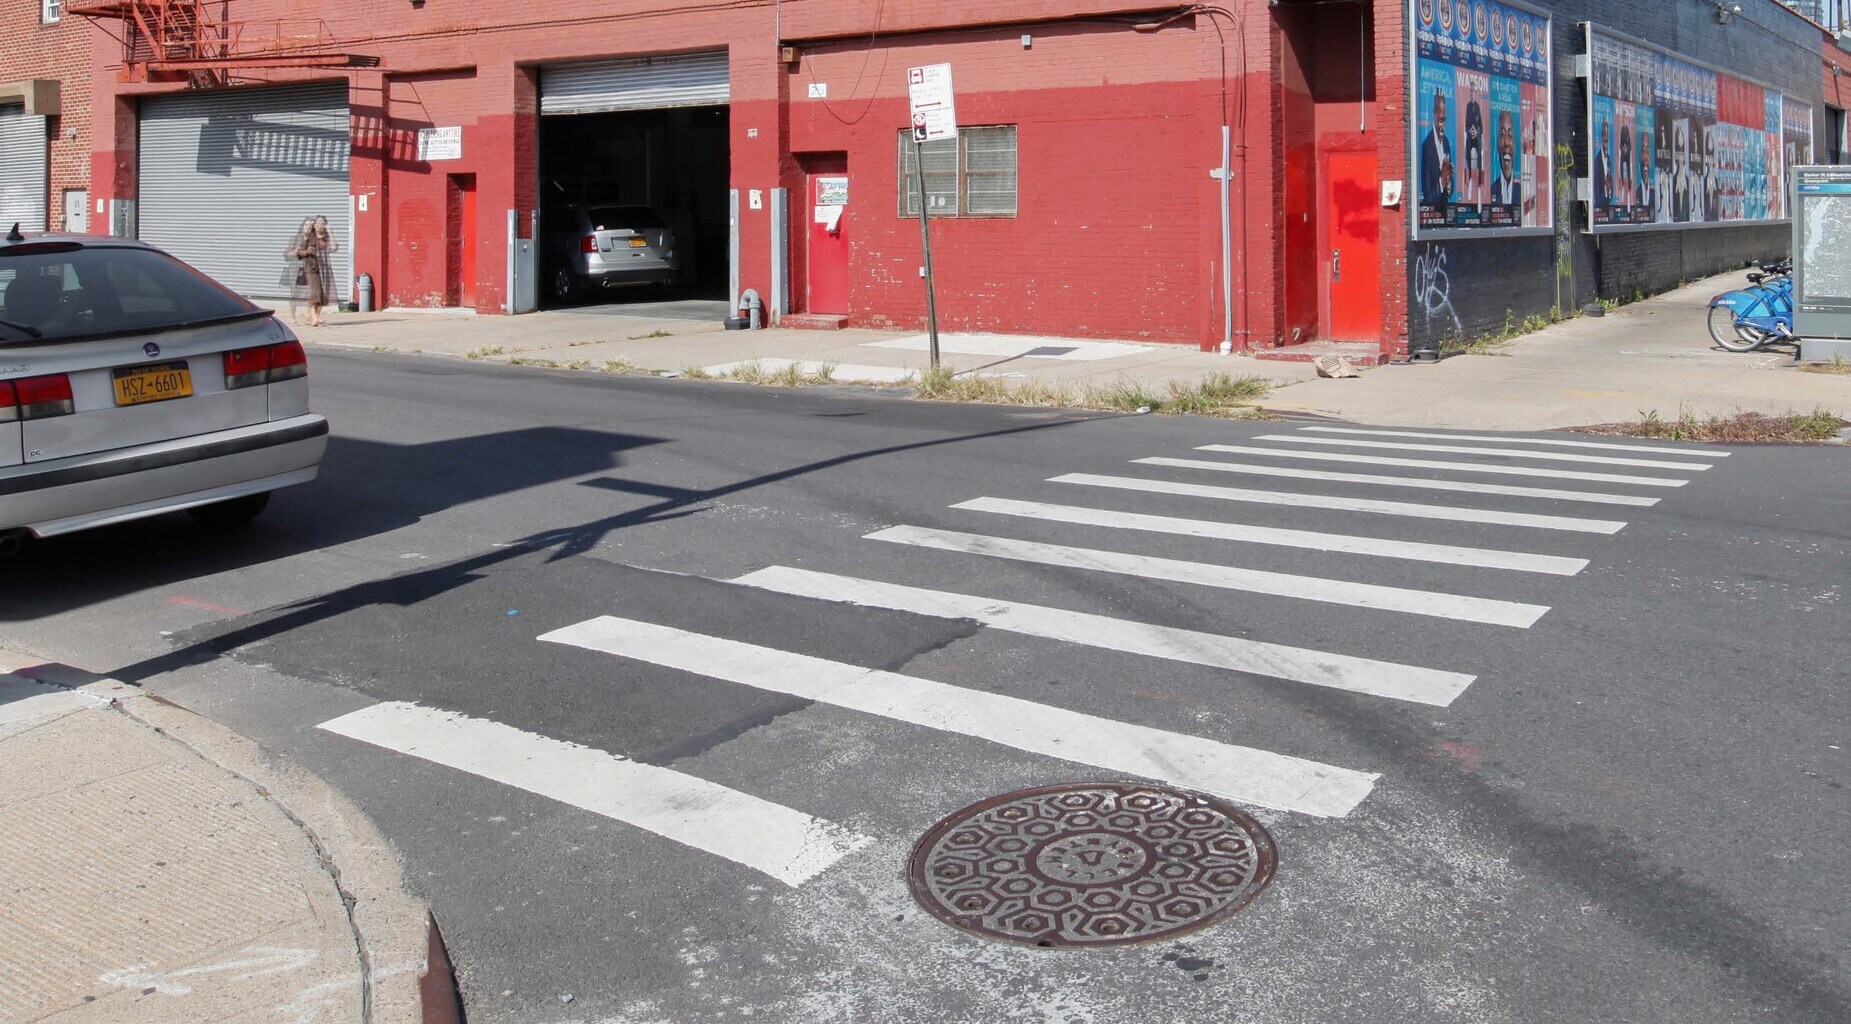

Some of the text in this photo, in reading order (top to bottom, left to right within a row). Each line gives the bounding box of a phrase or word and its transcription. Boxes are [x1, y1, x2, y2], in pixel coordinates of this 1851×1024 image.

[1456, 71, 1489, 92] WATSON
[122, 372, 185, 397] HSZ 6601
